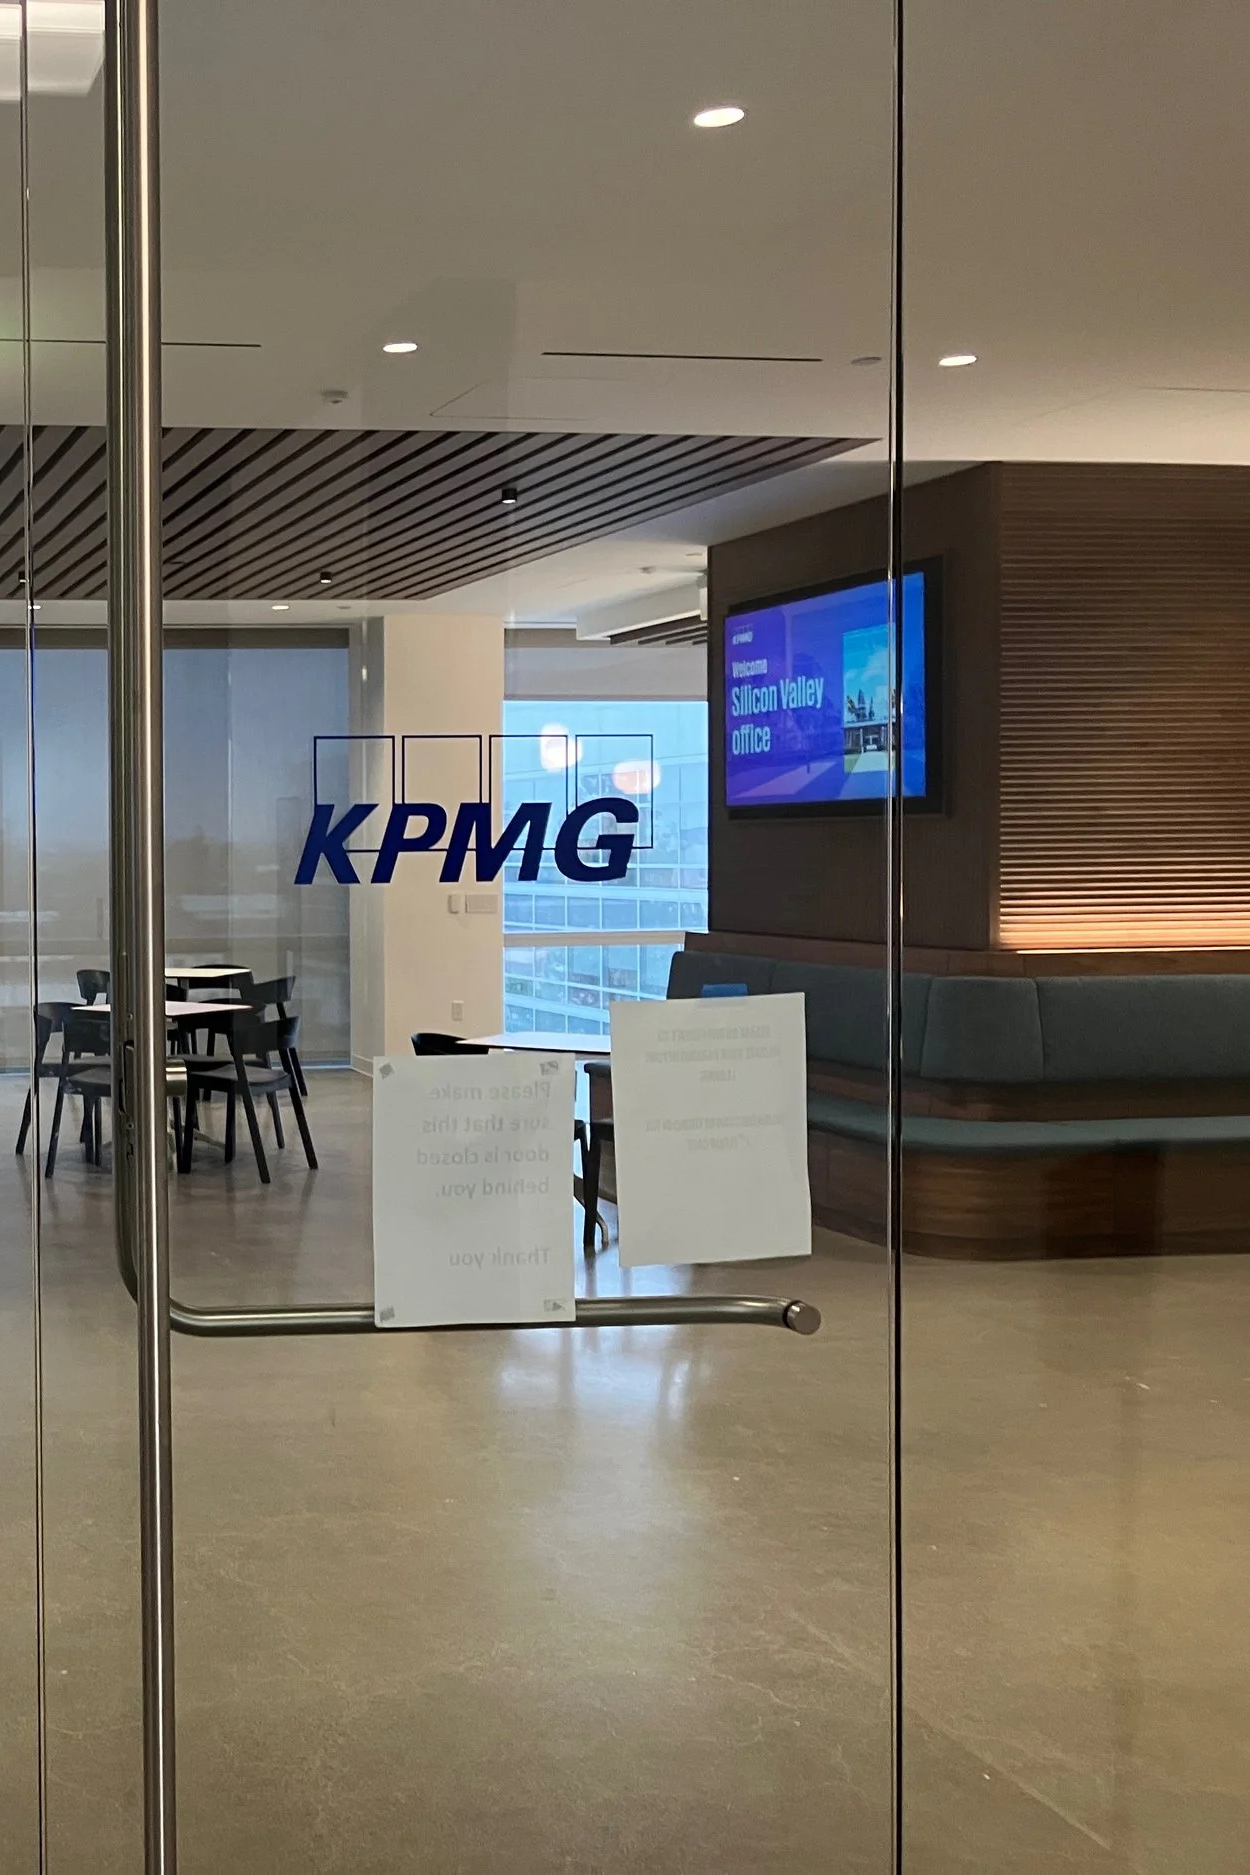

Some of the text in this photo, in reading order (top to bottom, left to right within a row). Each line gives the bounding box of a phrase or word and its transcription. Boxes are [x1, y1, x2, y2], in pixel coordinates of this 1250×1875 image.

[732, 659, 768, 678] Welcome
[731, 675, 824, 717] Silicon Valley
[732, 723, 771, 755] office
[294, 797, 639, 884] KPMG
